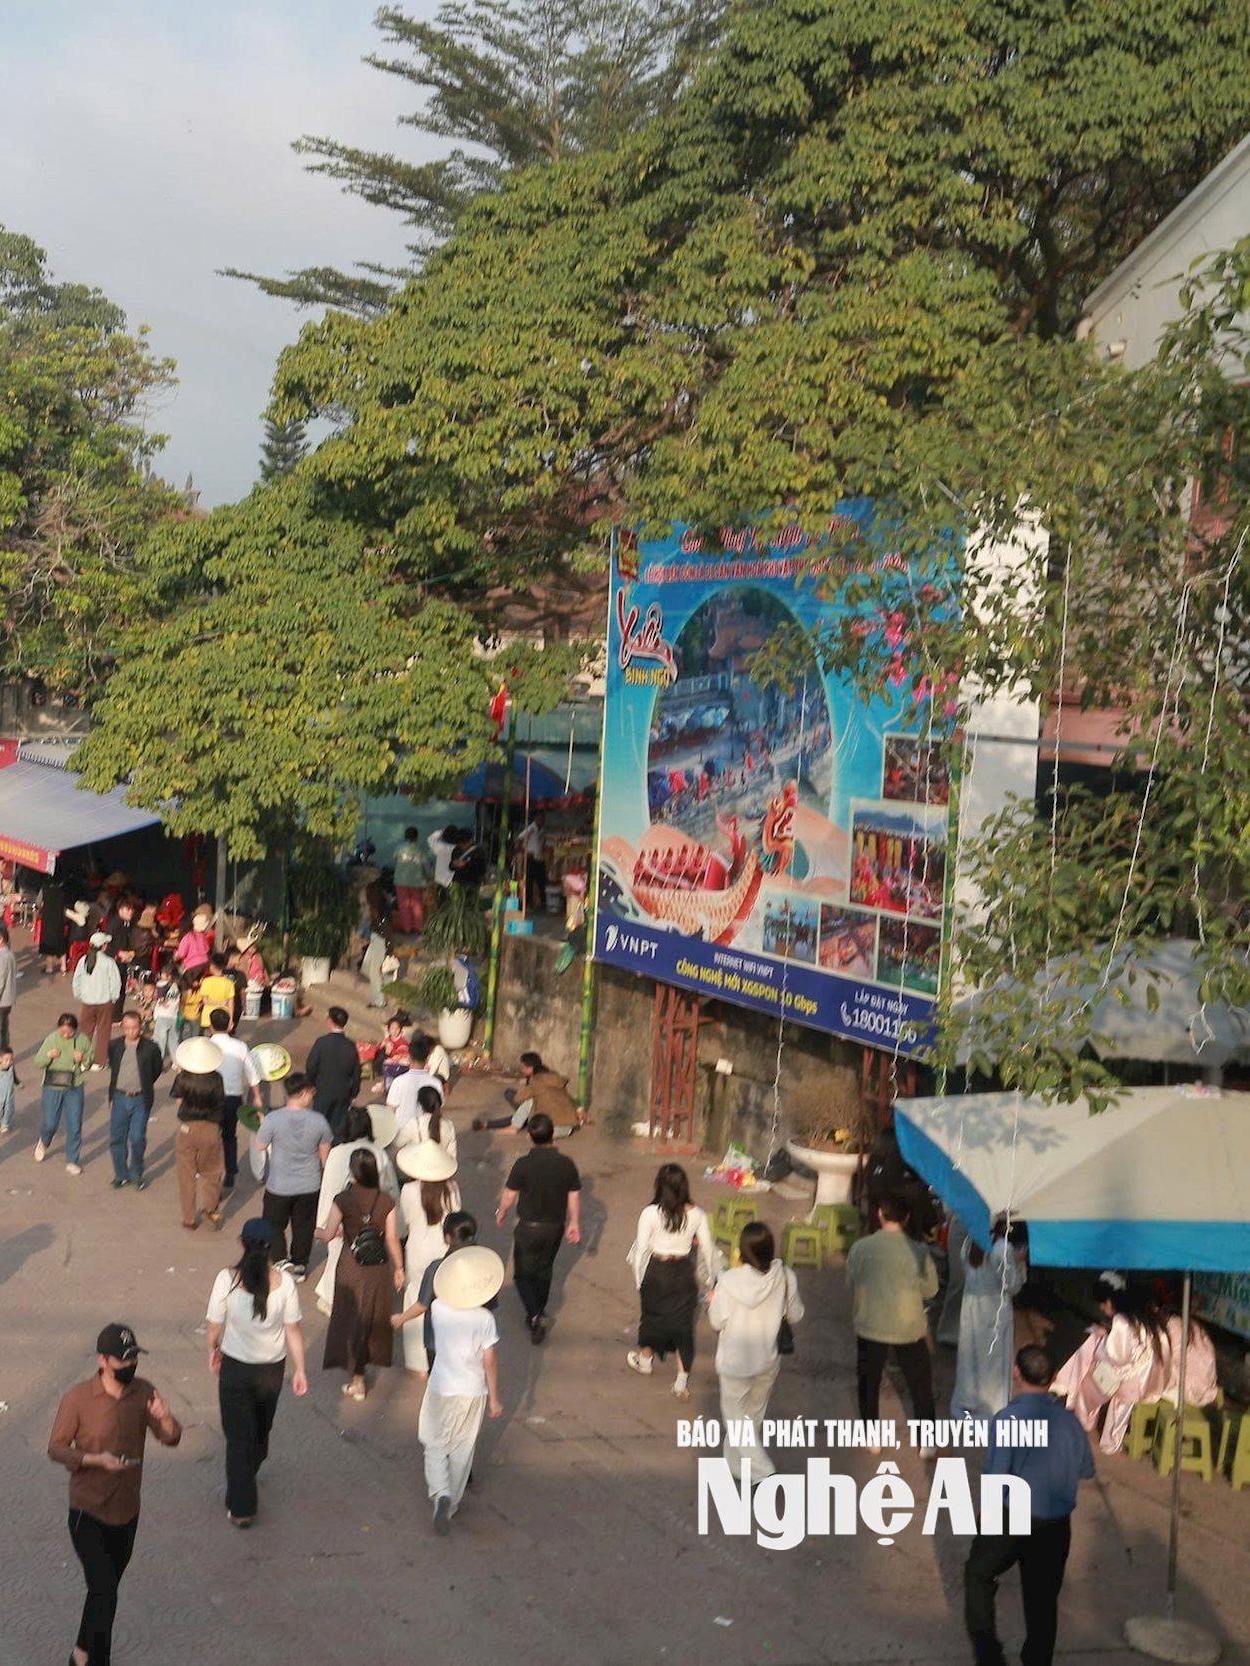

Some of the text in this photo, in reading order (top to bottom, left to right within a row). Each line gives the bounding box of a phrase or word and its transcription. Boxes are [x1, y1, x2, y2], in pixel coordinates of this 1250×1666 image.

[620, 935, 658, 959] VNPT
[714, 952, 743, 970] INTERNET
[756, 963, 774, 979] VNPT
[676, 958, 699, 979] CÔNG
[699, 967, 723, 989] NGHỆ
[724, 970, 740, 993] MỚI
[741, 981, 778, 1002] XGSPON
[793, 993, 818, 1016] Gbps
